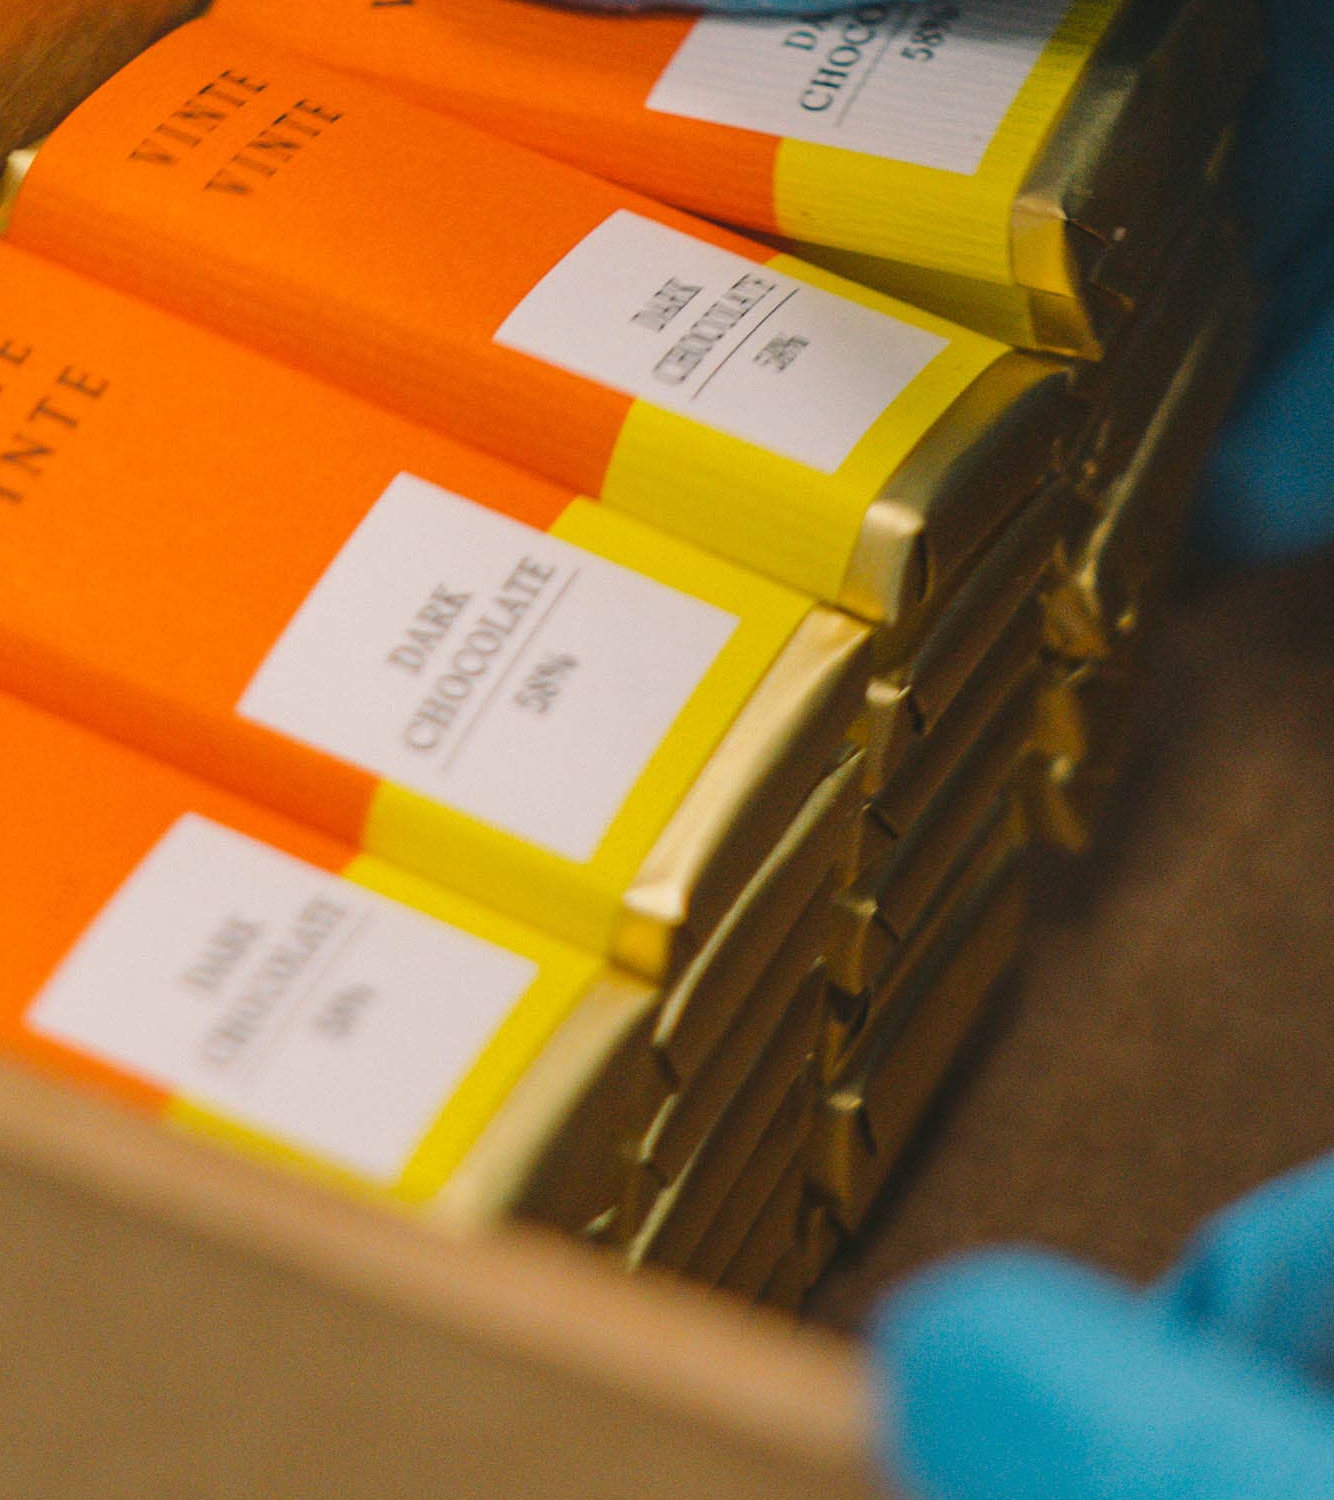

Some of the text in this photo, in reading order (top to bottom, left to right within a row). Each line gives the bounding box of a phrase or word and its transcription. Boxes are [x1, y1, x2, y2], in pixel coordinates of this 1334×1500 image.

[799, 4, 890, 112] CHOCO
[128, 70, 268, 168] VINTE
[204, 99, 343, 195] VINTE
[387, 583, 473, 672] DARK
[403, 555, 556, 752] CHOCOLATE
[512, 654, 578, 713] 58%
